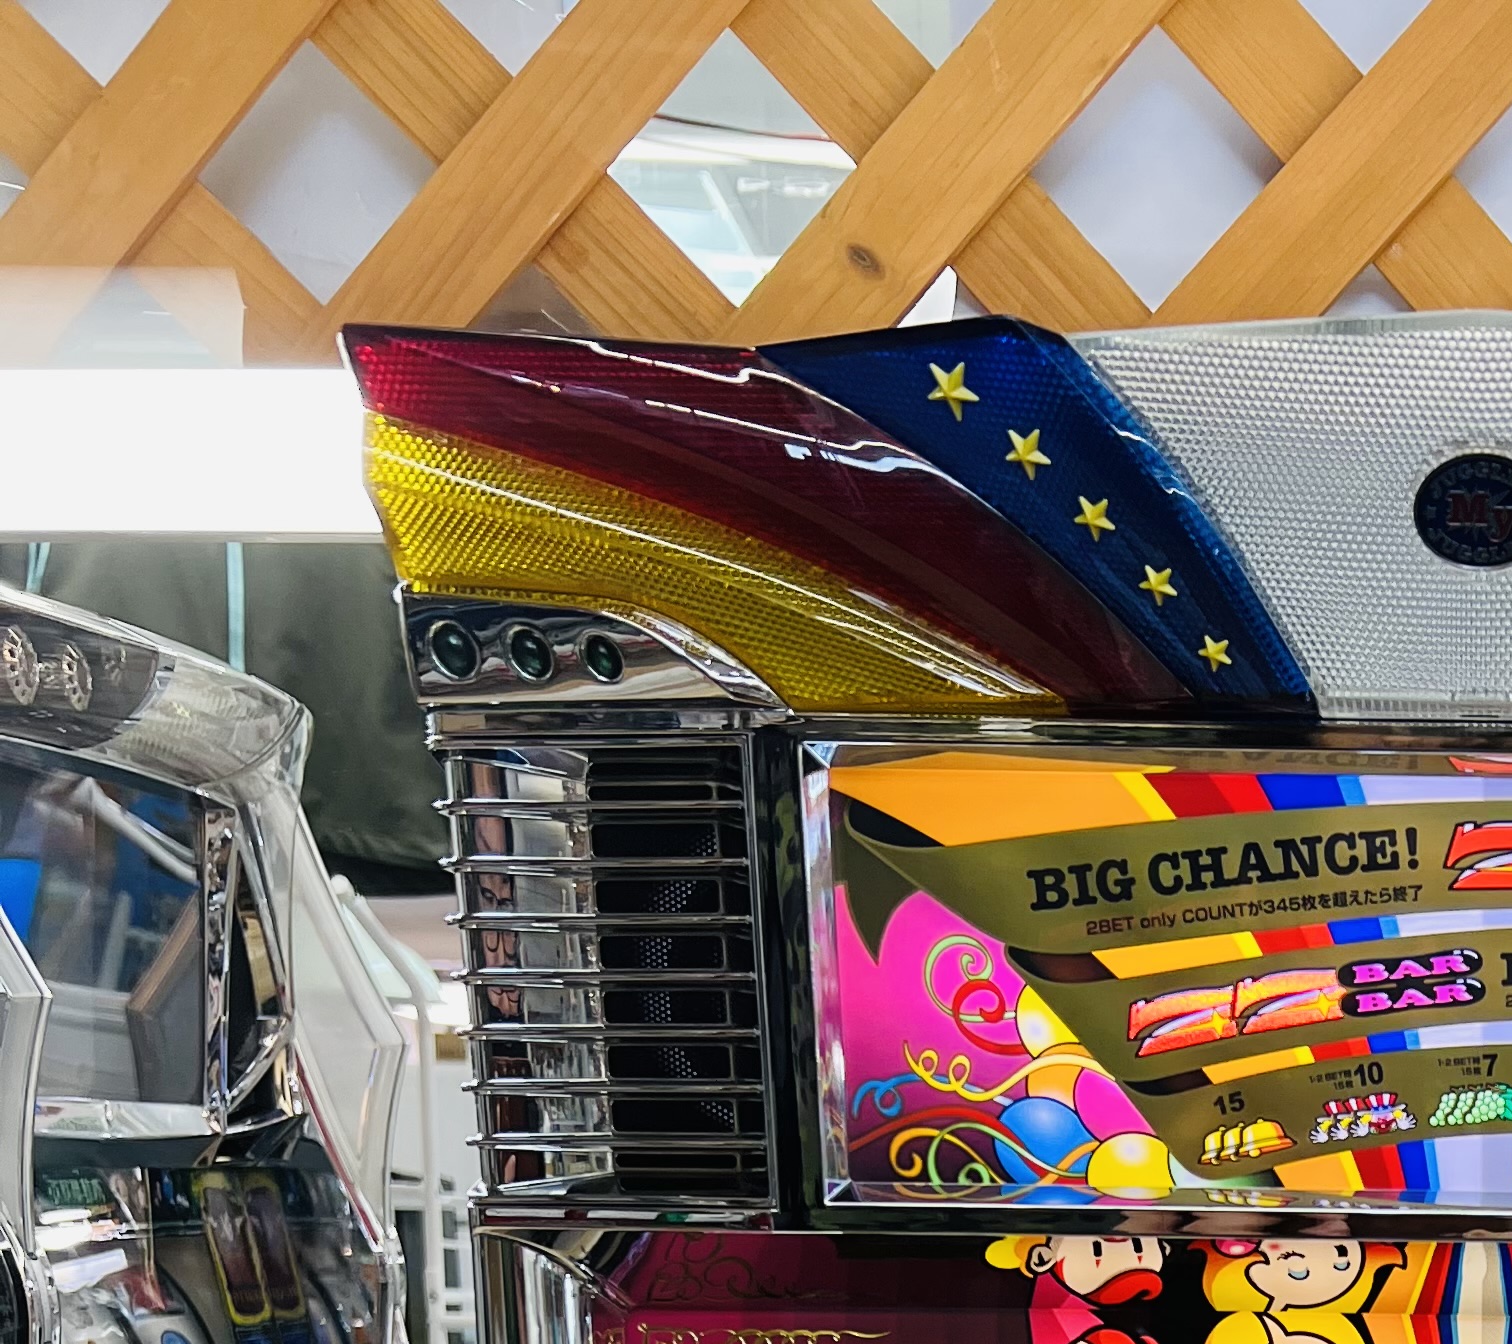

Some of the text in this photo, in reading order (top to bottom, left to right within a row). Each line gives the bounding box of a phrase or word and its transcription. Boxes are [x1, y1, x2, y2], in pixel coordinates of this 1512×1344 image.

[1027, 857, 1137, 911] BIG
[1147, 827, 1421, 897] CHANCE!
[1085, 915, 1135, 936] 2BET
[1139, 908, 1177, 931] only
[1352, 953, 1472, 985] BAR
[1355, 983, 1476, 1014] BAR
[1353, 1061, 1385, 1087] 10
[1482, 1053, 1499, 1078] 7
[1212, 1090, 1246, 1116] 15
